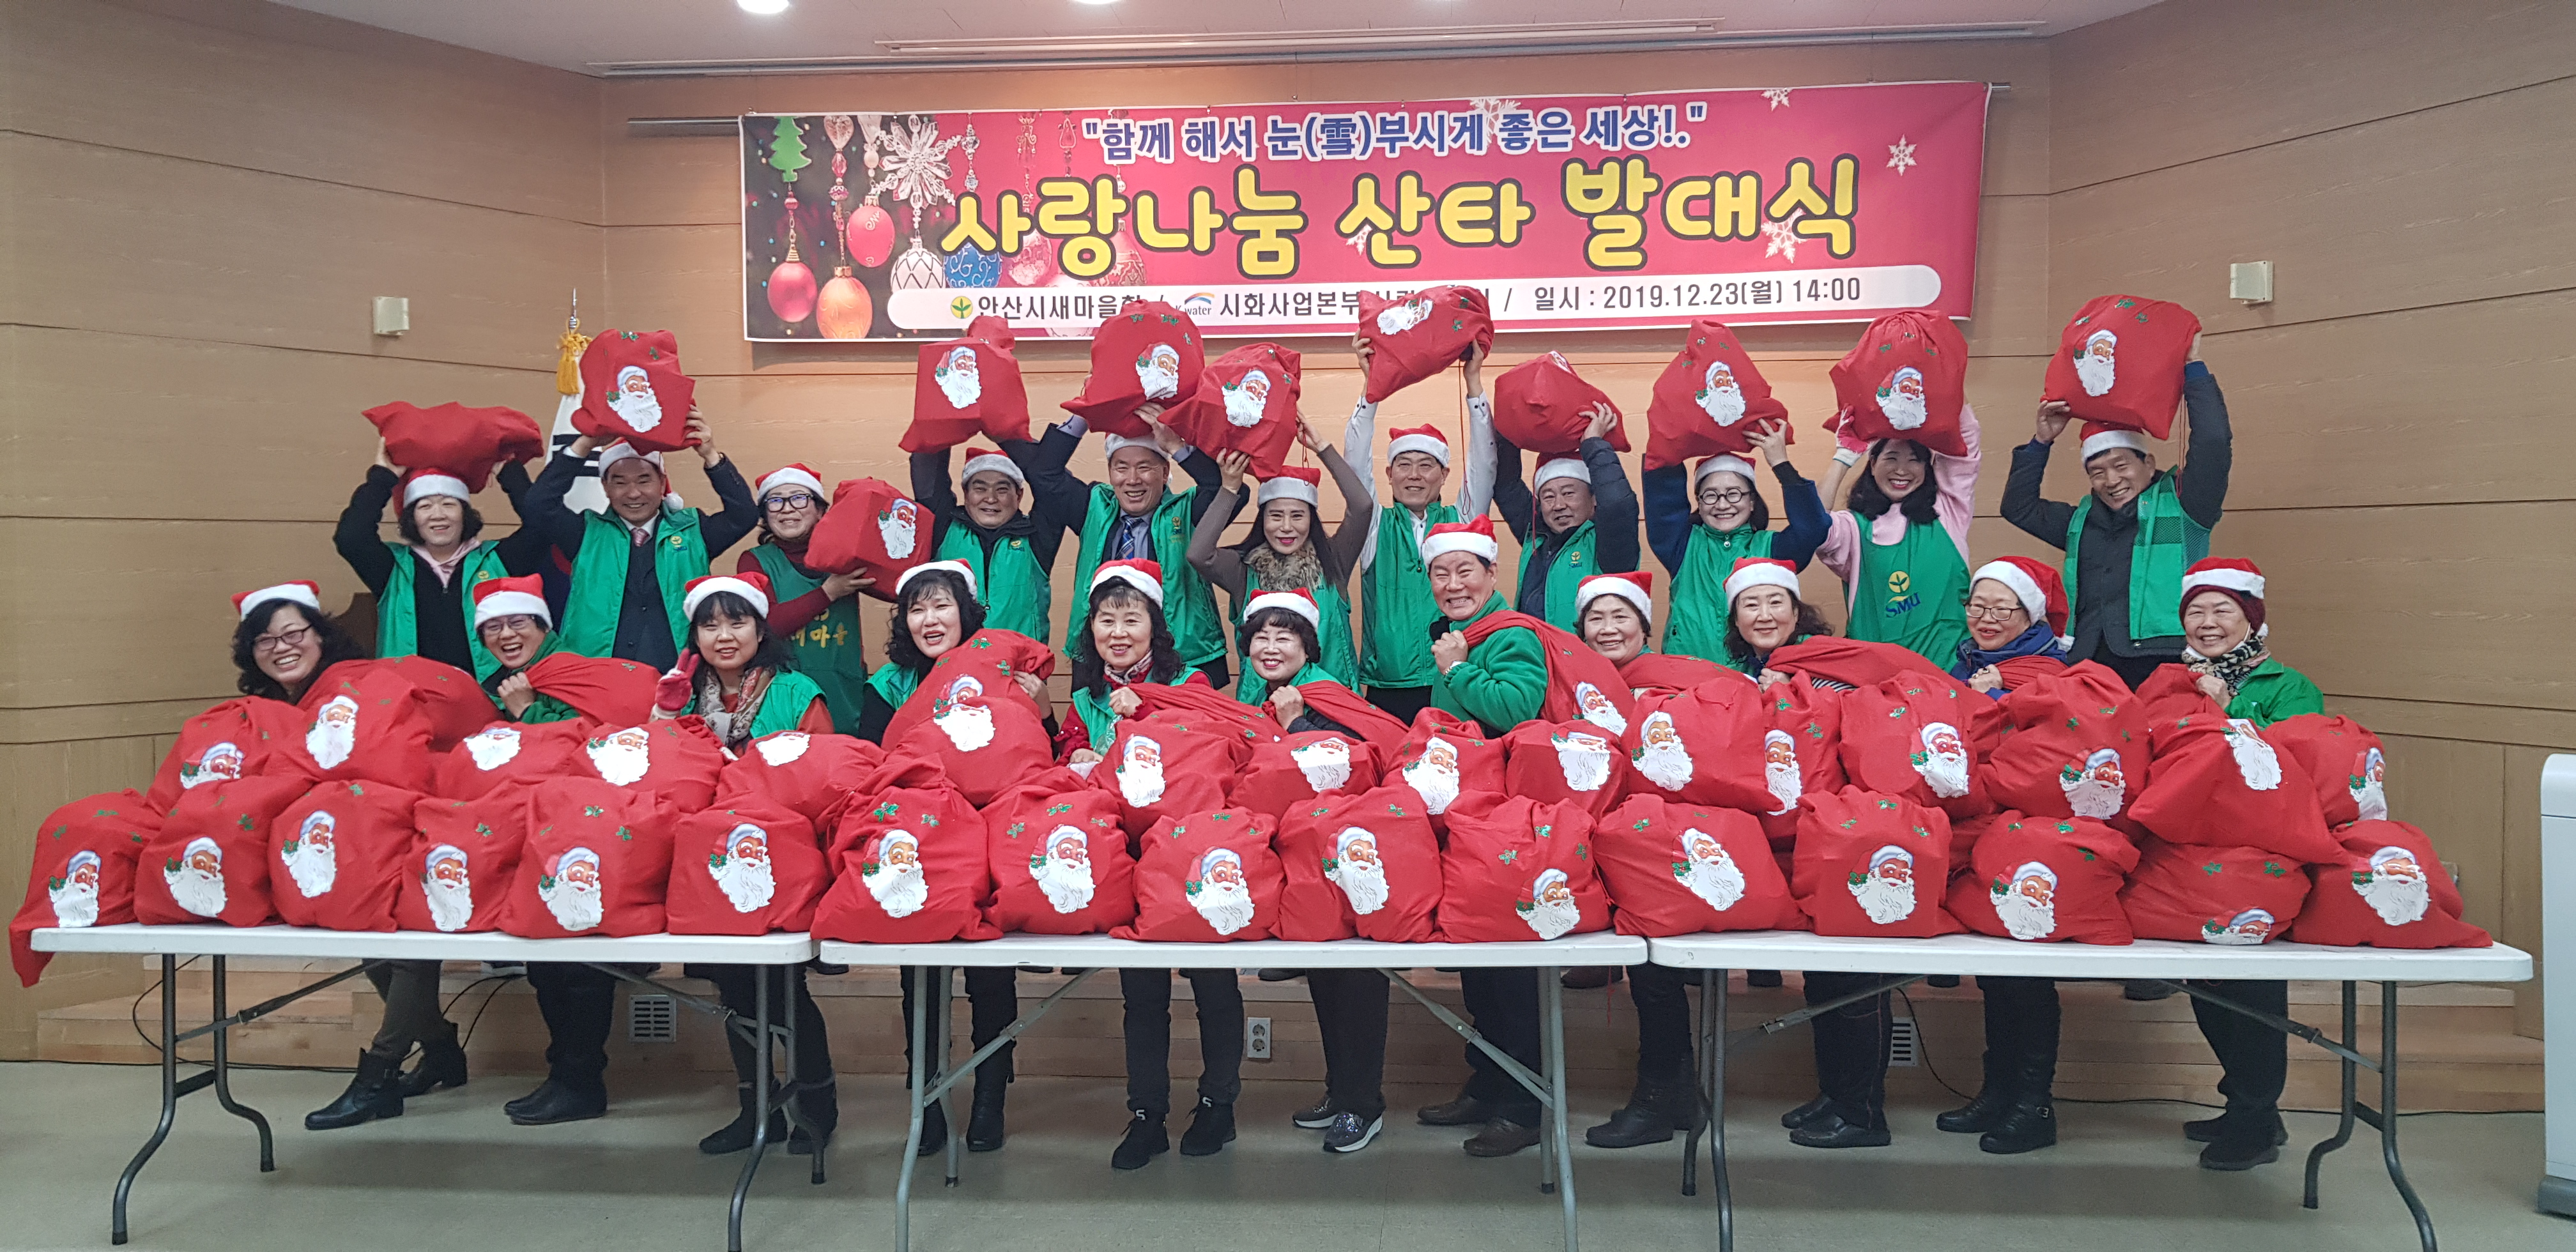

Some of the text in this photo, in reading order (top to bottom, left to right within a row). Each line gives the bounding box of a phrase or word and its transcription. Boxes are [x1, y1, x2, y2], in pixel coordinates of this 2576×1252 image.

[1086, 121, 1172, 160] "함께
[1184, 119, 1252, 158] 해서
[1268, 113, 1483, 158] 눈(雪)부시게
[1498, 112, 1572, 151] 좋은
[940, 153, 1860, 279] 사랑나눔 산타 발대식
[1220, 292, 1360, 317] 시화사업본부
[1534, 286, 1580, 311] 일시
[1603, 279, 1782, 309] 2019.12.23(월)
[1793, 277, 1861, 303] 14:00
[1885, 592, 1921, 618] SMU
